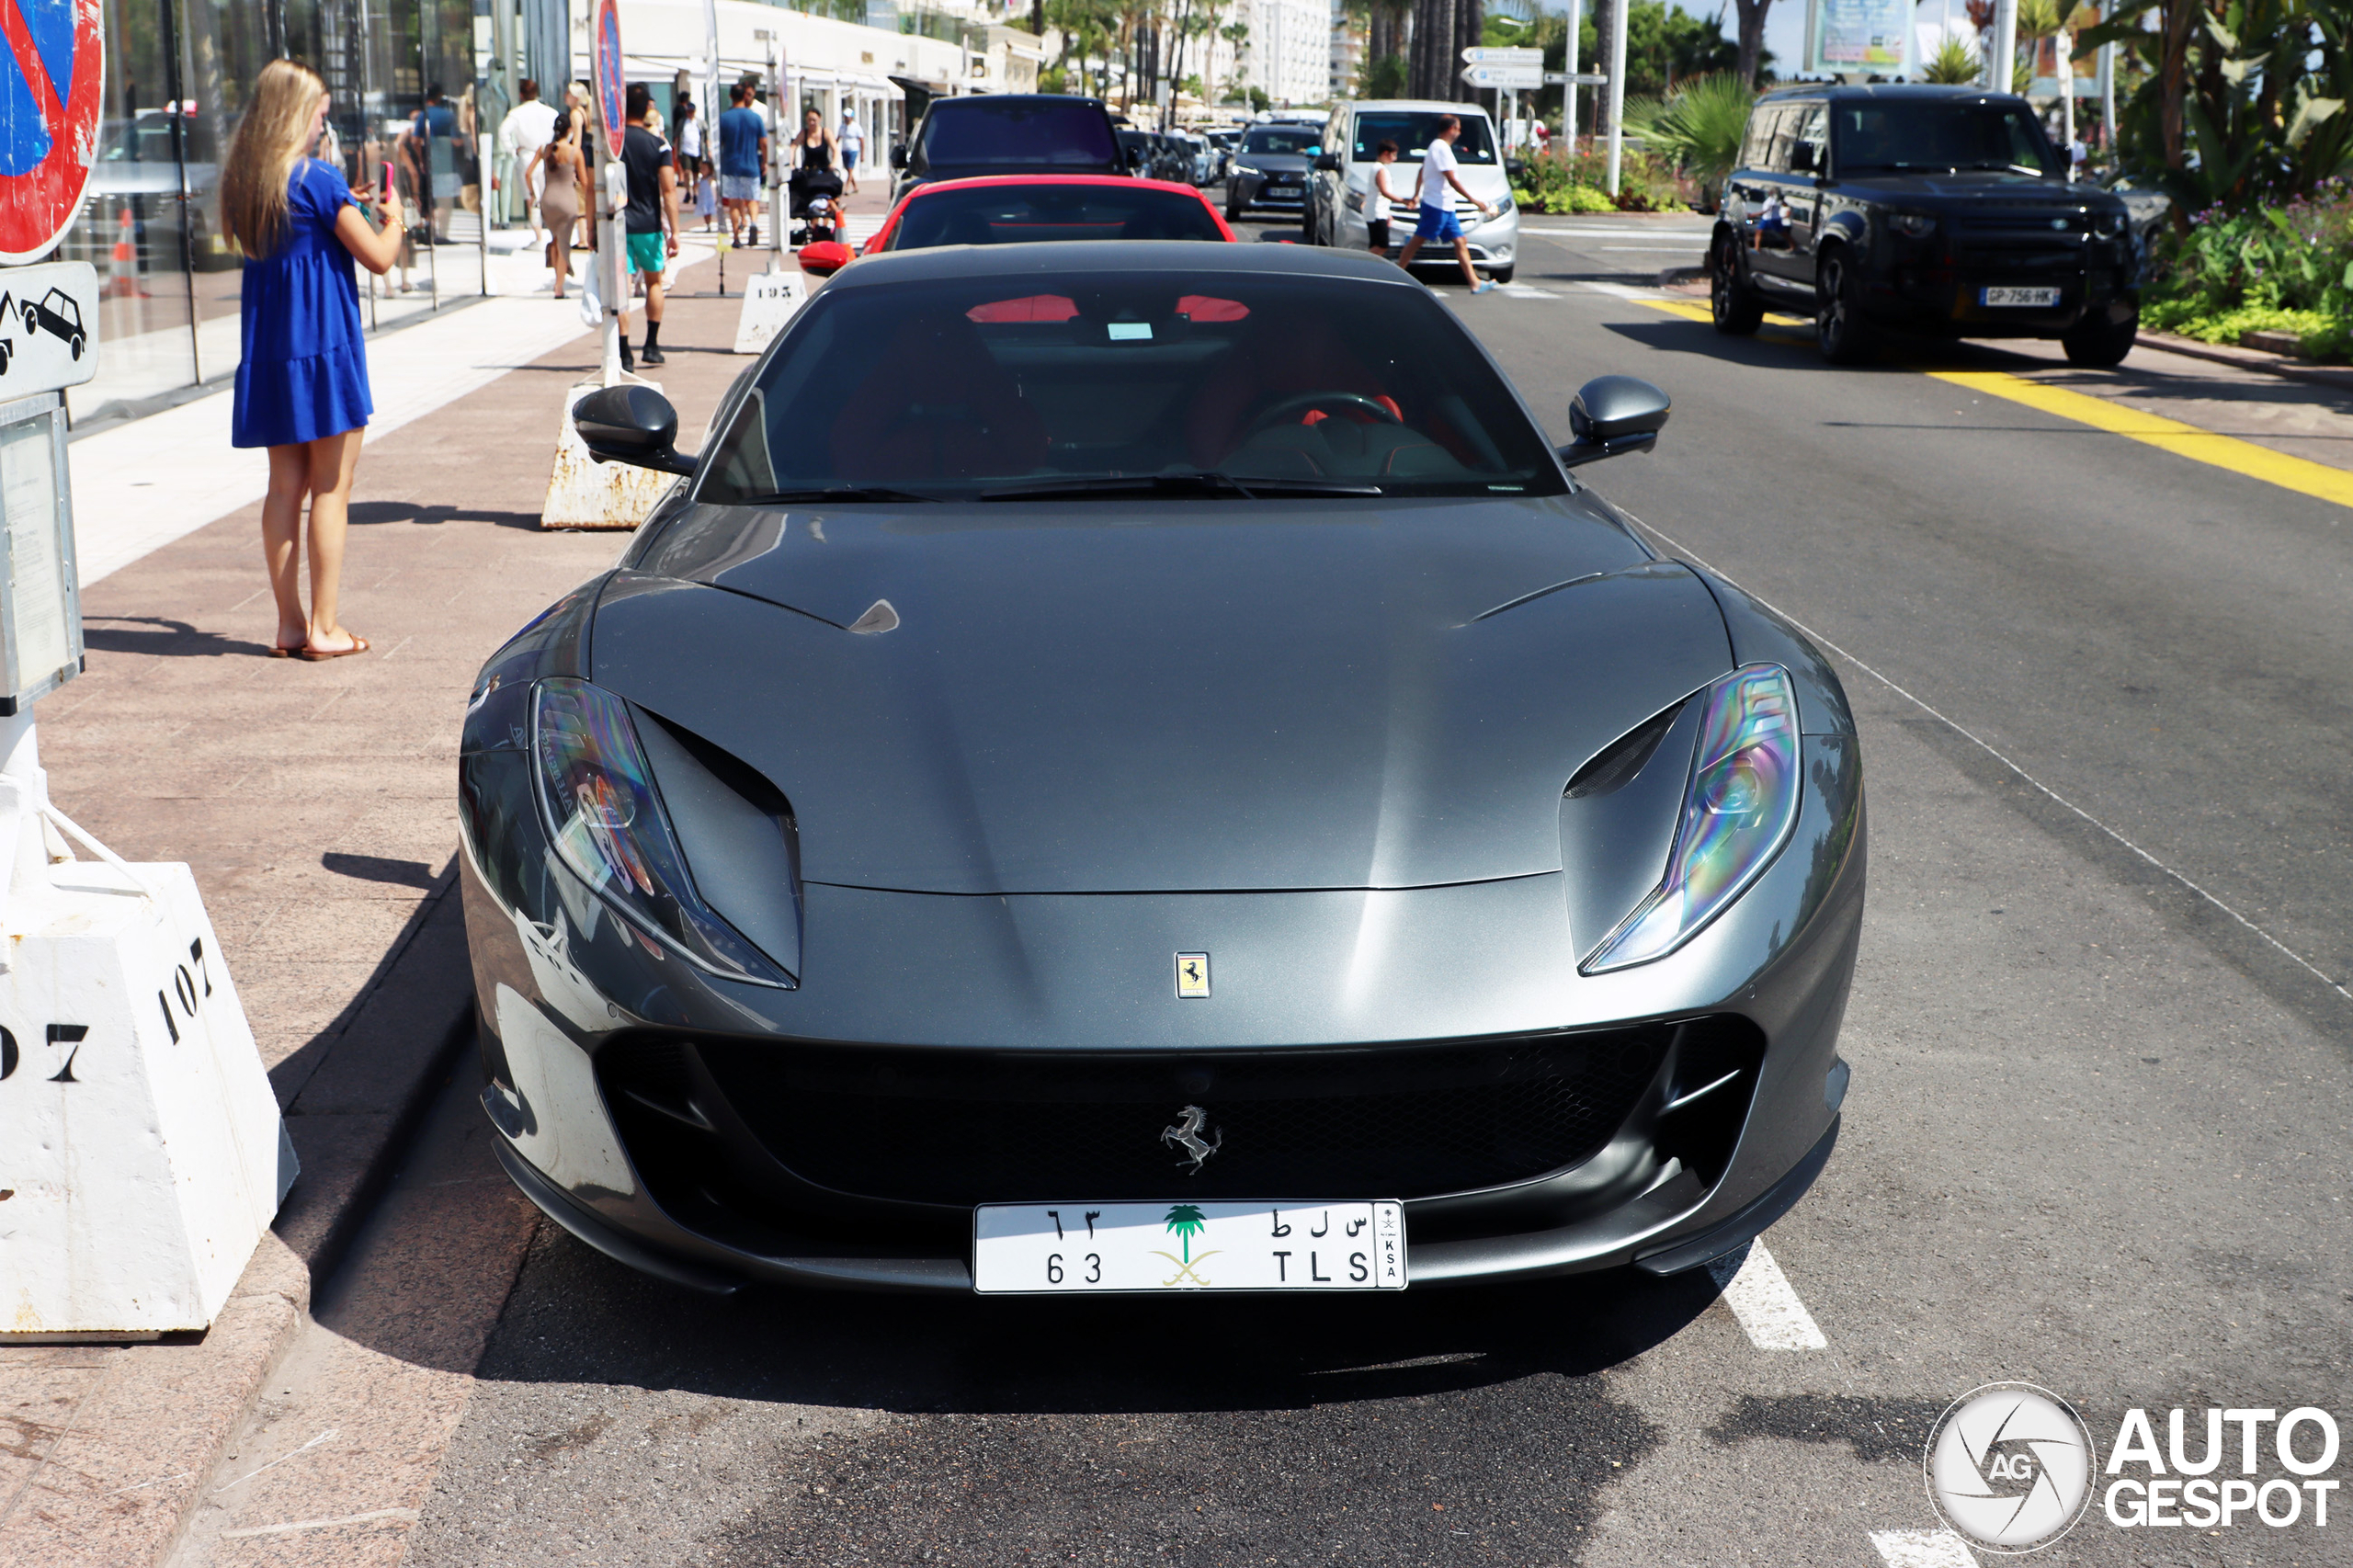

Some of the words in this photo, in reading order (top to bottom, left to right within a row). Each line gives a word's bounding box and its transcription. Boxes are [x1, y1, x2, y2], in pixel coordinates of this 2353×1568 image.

[157, 937, 212, 1046] 107
[1047, 1252, 1101, 1284] 63
[1272, 1251, 1369, 1282] TLS
